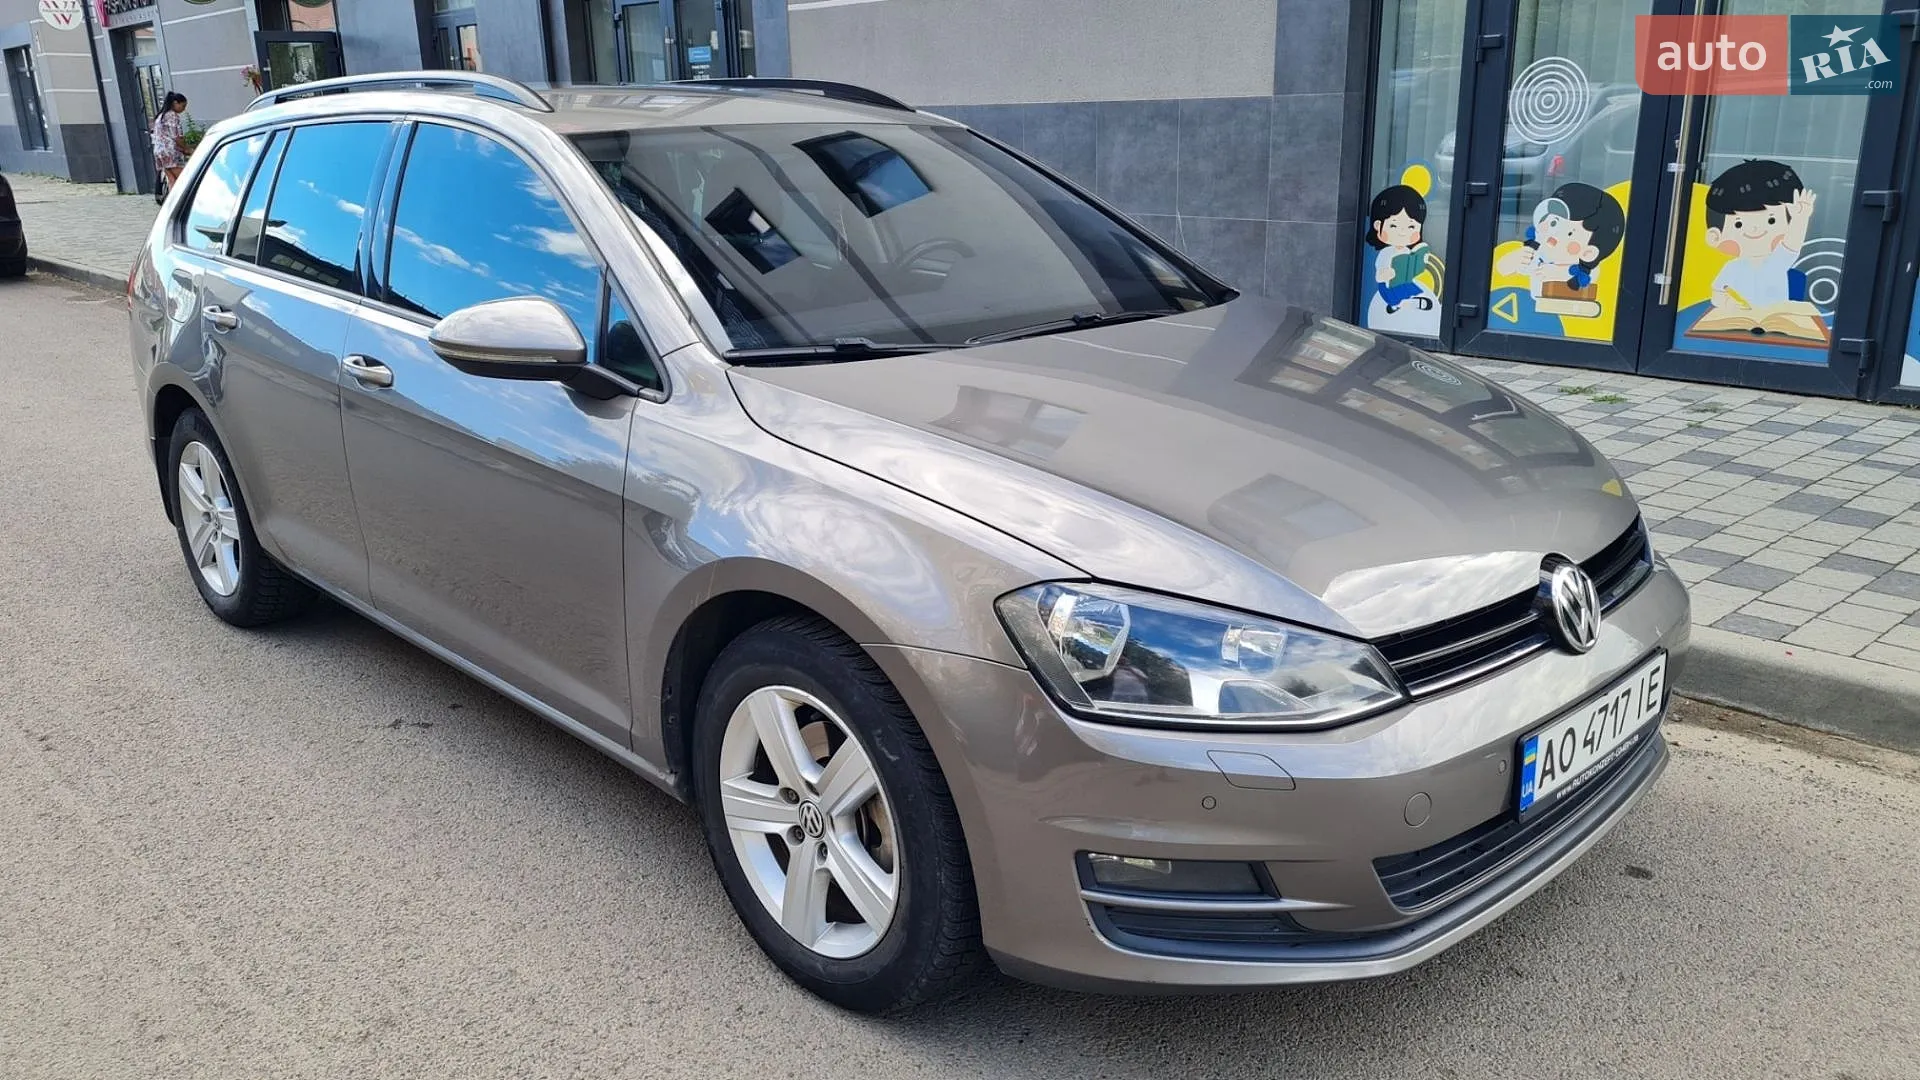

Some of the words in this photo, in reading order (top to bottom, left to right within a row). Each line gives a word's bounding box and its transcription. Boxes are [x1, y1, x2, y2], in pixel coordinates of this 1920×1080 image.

[1539, 727, 1576, 789] AO
[1583, 688, 1632, 755] 4717
[1637, 665, 1661, 720] IE
[1522, 780, 1534, 798] UA
